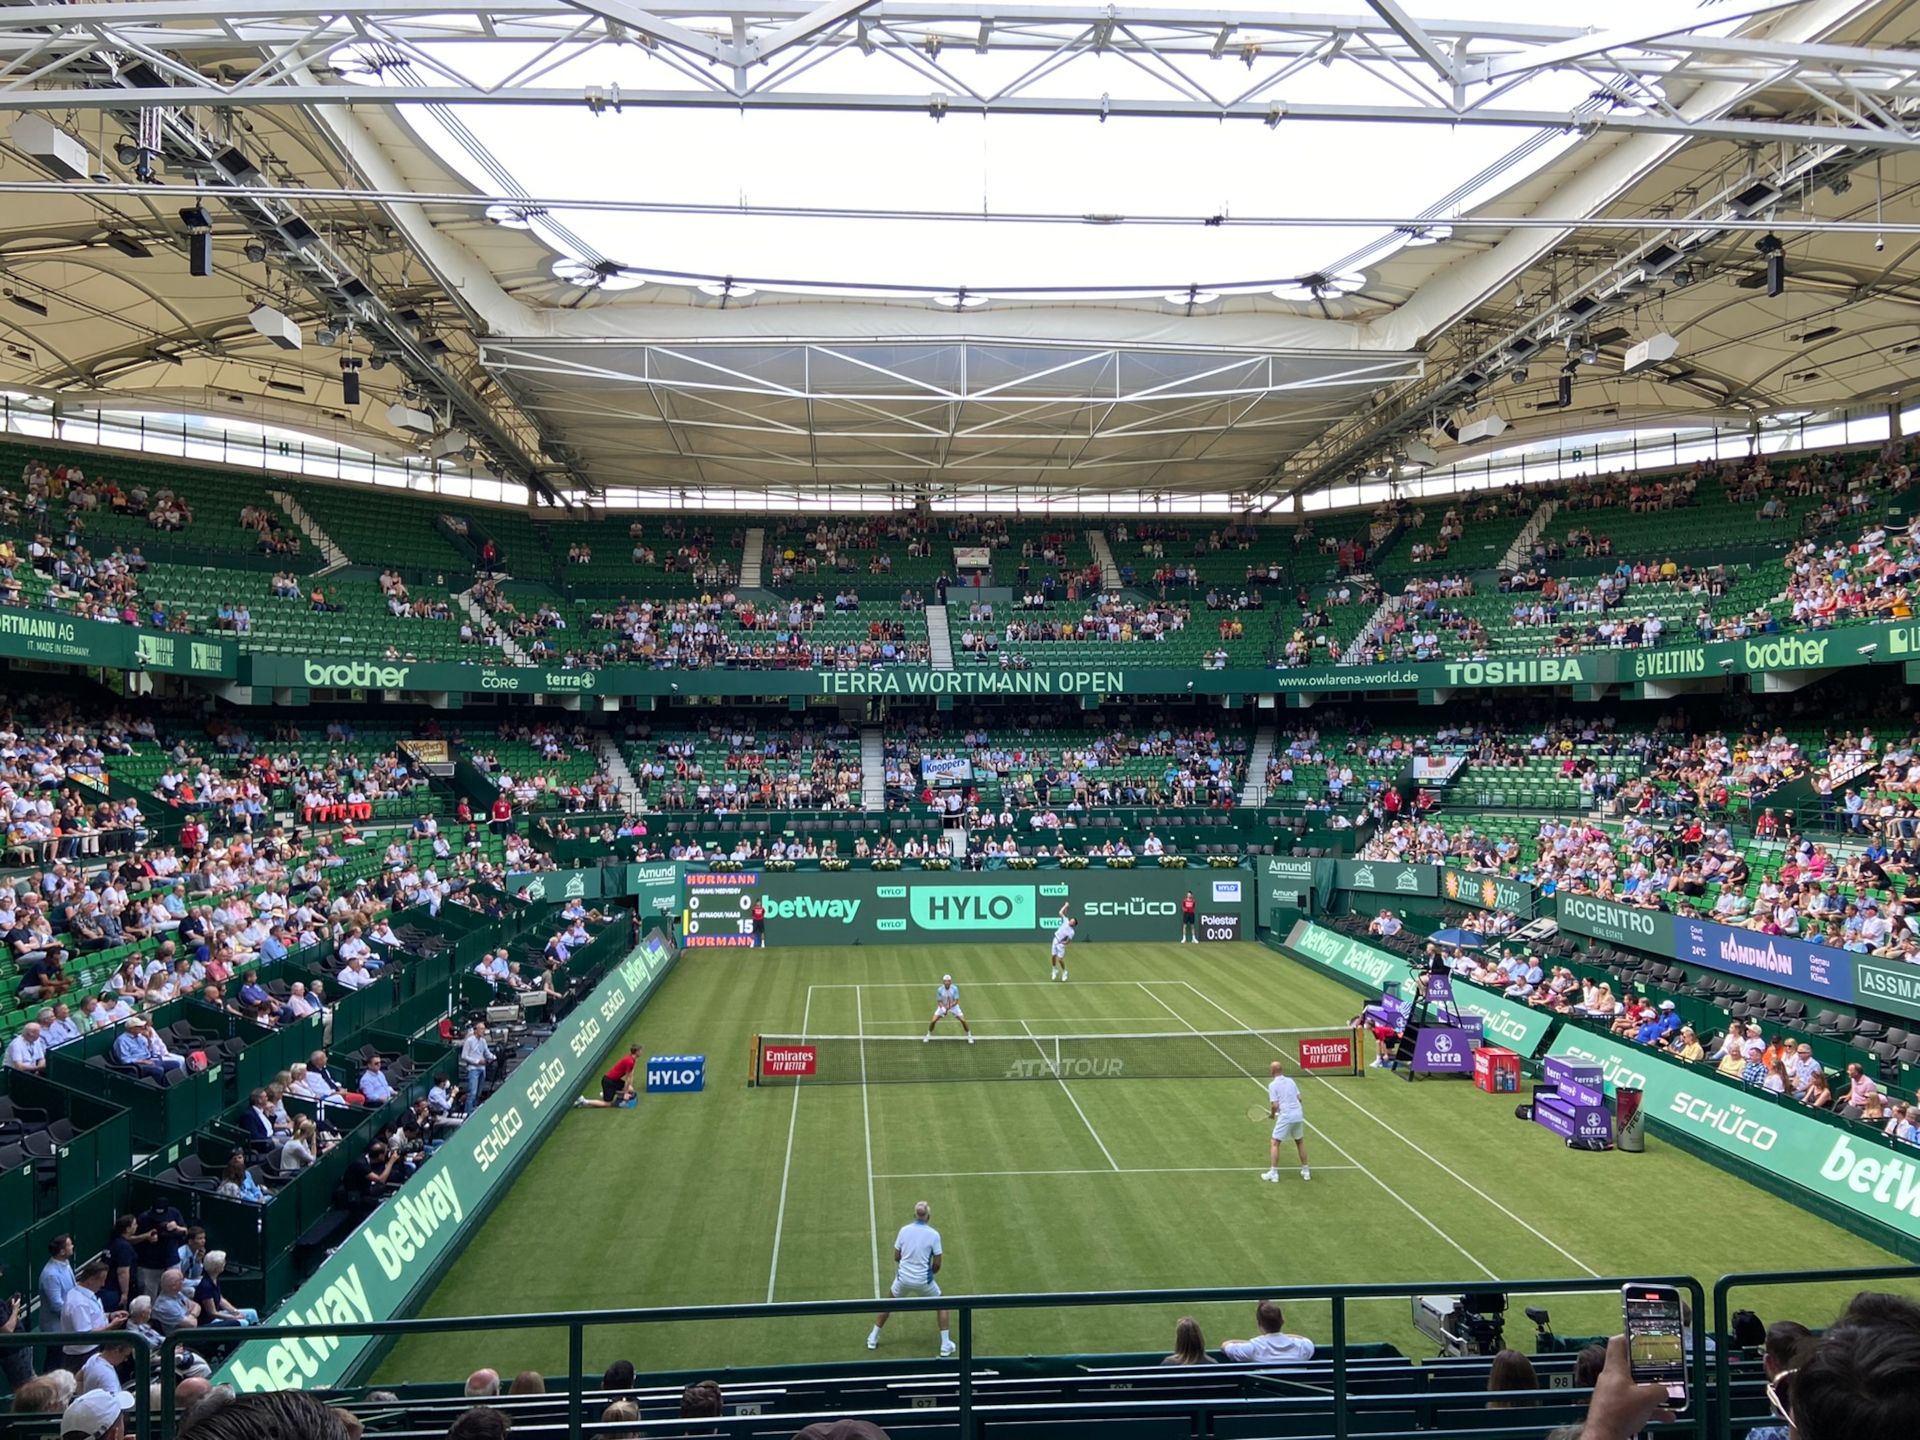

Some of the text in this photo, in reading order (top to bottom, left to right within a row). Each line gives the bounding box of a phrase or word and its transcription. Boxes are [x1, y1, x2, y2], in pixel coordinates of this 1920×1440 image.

[0, 614, 75, 641] RTMANN AG
[37, 642, 54, 653] MADE
[54, 644, 62, 654] IN
[1745, 636, 1829, 670] brother
[1646, 648, 1705, 675] VELTINS
[304, 660, 410, 688] brother
[545, 673, 580, 686] terra
[1278, 671, 1420, 687] www.owlarena-world.de
[1444, 659, 1584, 685] TOSHIBA
[819, 671, 1124, 693] TERRA WORTMANN OPEN
[926, 760, 966, 774] Knoppers
[638, 865, 676, 879] Amundi
[1268, 860, 1312, 873] Amundi
[689, 895, 751, 911] 0 0
[761, 895, 861, 923] betway
[1084, 897, 1177, 916] SCHÜCO
[1201, 915, 1239, 926] Polestar
[1564, 897, 1655, 936] ACCENTRO
[689, 918, 753, 934] 0 15
[1206, 928, 1233, 940] 0:00
[1592, 926, 1624, 942] REAL ESTATE
[1301, 925, 1344, 965] betway
[1343, 943, 1395, 985] betway
[1809, 954, 1830, 967] Genau
[1429, 988, 1449, 996] terra
[600, 988, 626, 1022] SCHÜCO
[570, 1017, 601, 1058] SCHÜCO
[766, 1050, 814, 1062] Emirates
[1302, 1043, 1349, 1055] Emirates
[1426, 1051, 1462, 1063] terra
[785, 1062, 807, 1071] BETTER
[1321, 1054, 1342, 1063] BETTER
[1061, 1058, 1123, 1077] TOUR
[1566, 1046, 1647, 1090] ÜCO
[526, 1057, 566, 1109] SCHÜCO
[1669, 1090, 1779, 1151] SCHÜCO
[1580, 1125, 1607, 1135] terra
[473, 1106, 524, 1173] SCHÜCO
[363, 1166, 464, 1281] betway
[1553, 1376, 1569, 1388] 98
